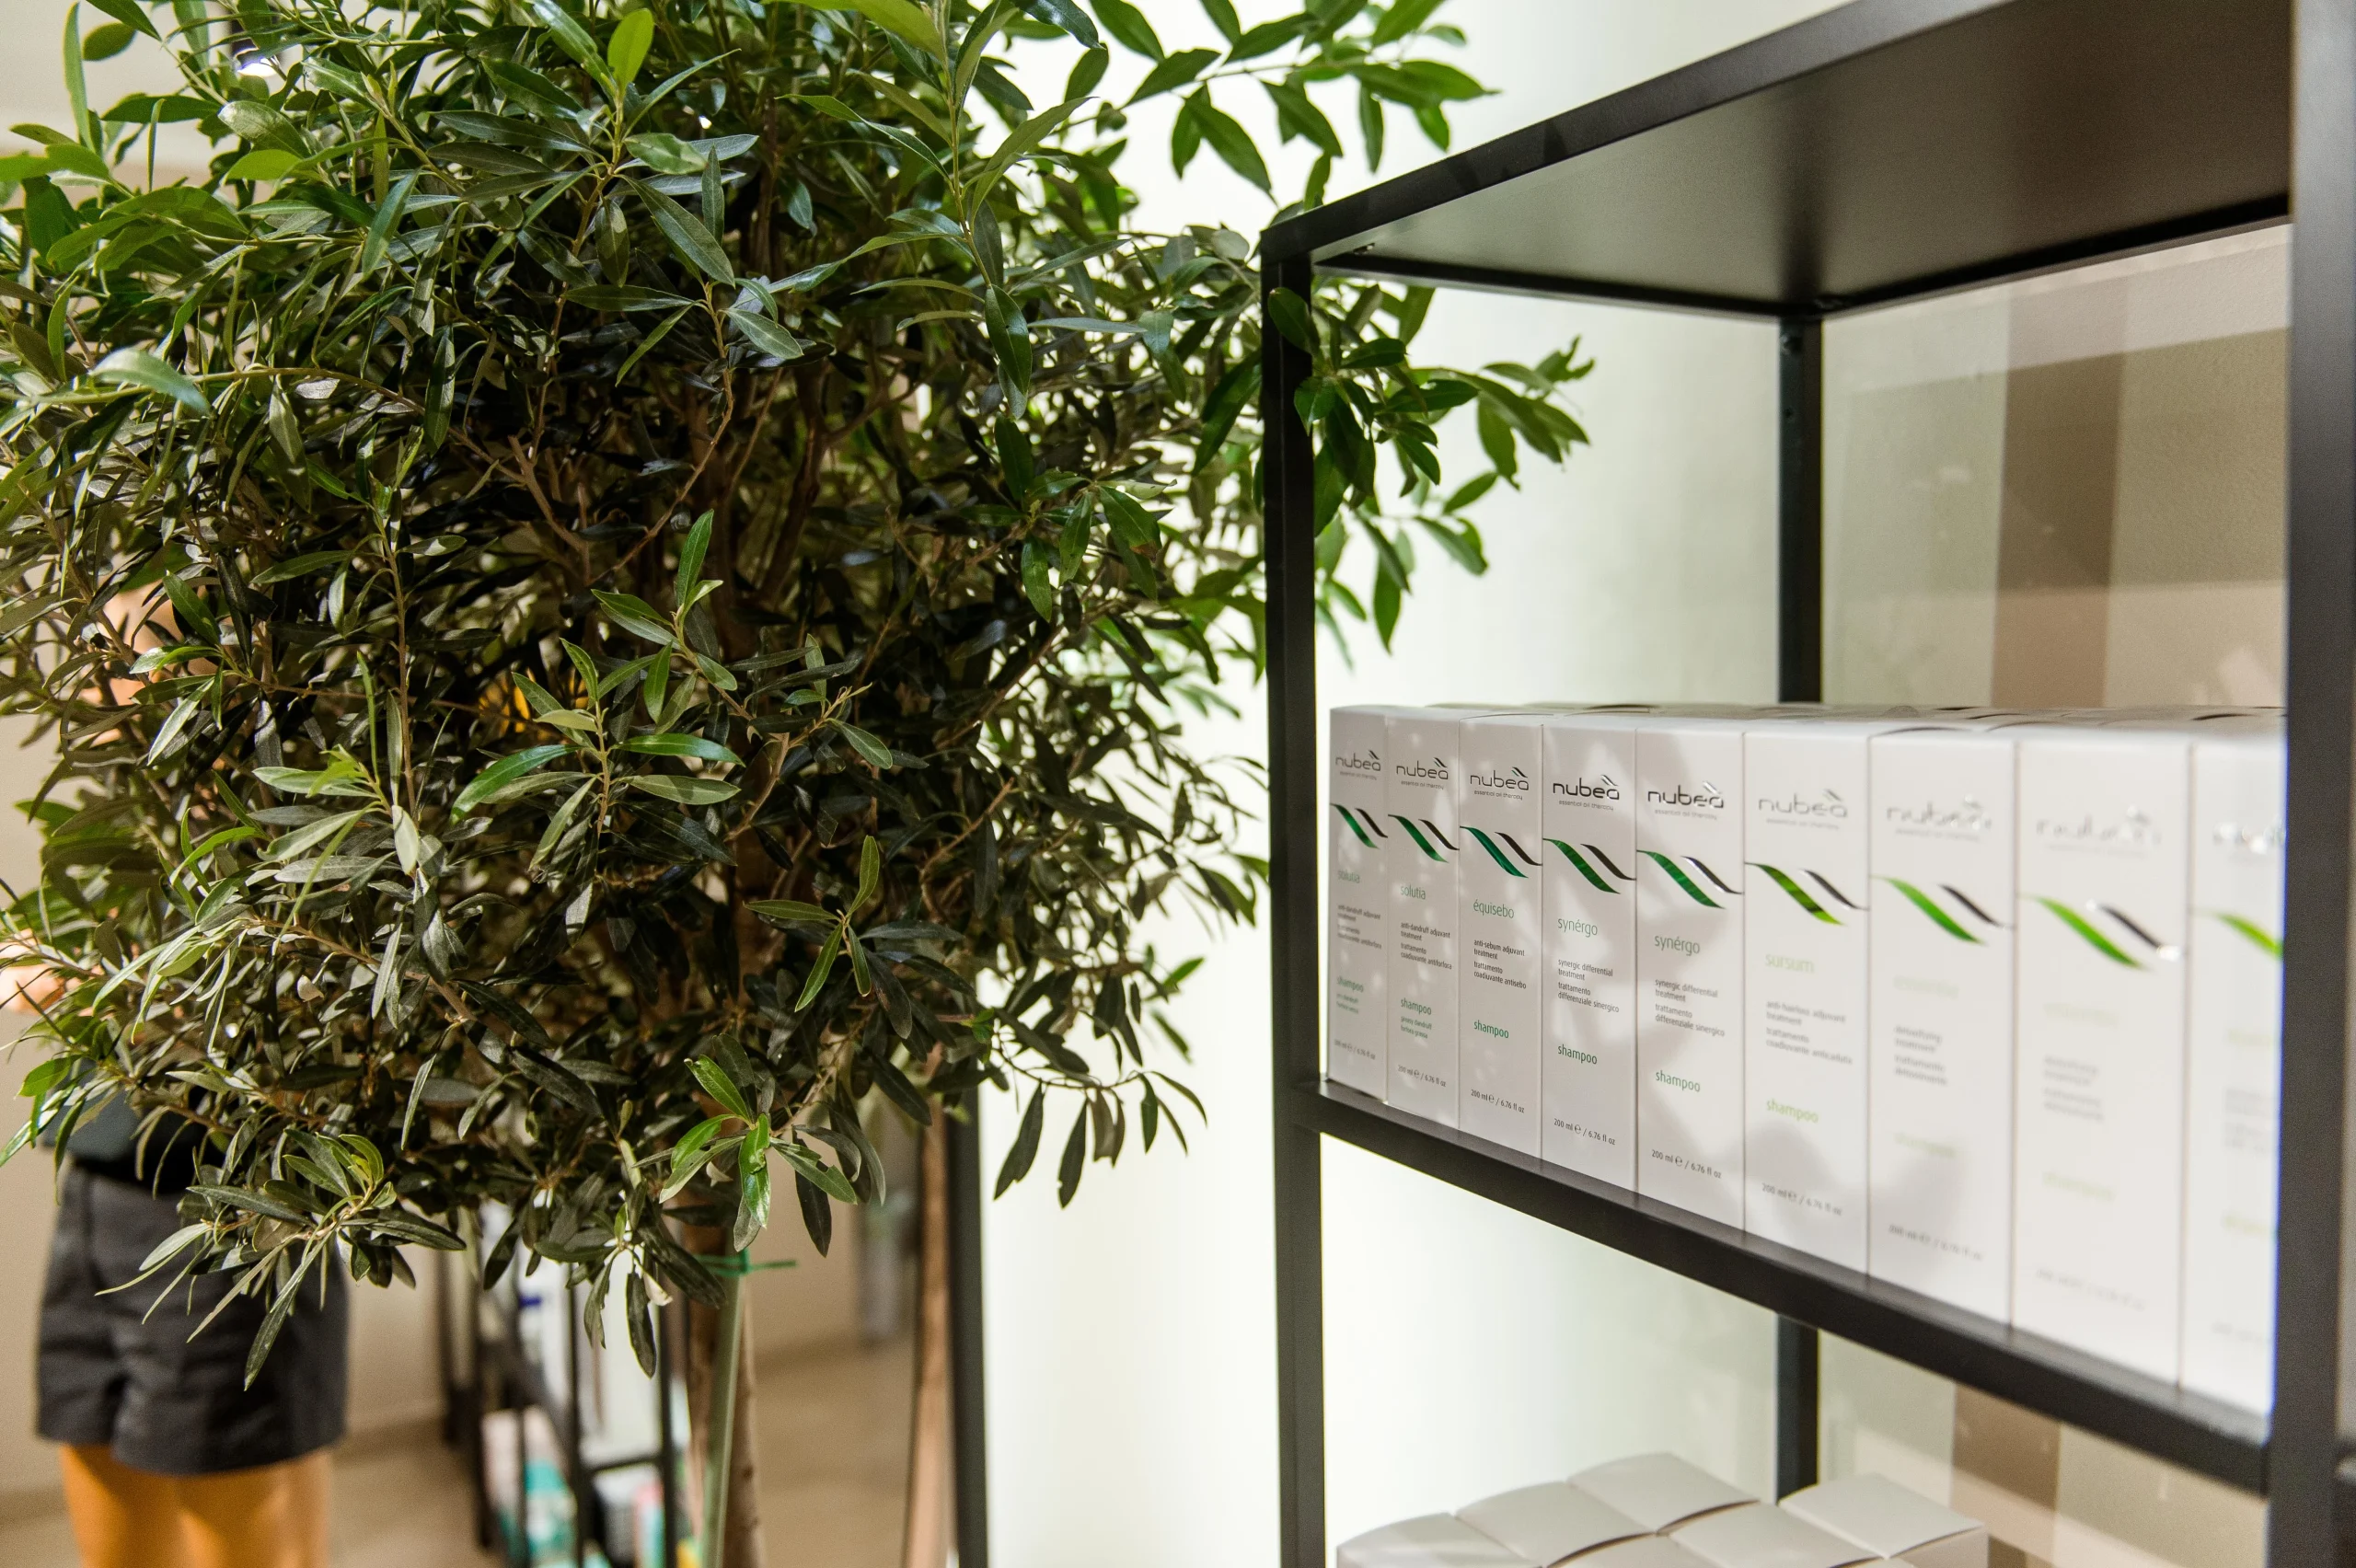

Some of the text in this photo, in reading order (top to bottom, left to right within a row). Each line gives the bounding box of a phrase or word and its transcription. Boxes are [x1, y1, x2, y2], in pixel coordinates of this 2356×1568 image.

[1396, 757, 1449, 779] nubeà
[1470, 767, 1529, 790] nubeà
[1553, 774, 1620, 801] nubeà
[1503, 792, 1523, 801] therapy
[1591, 802, 1614, 812] therapy
[1401, 884, 1426, 900] solutia
[1473, 899, 1514, 918] équisebo
[1557, 917, 1599, 938] synérgo
[1473, 940, 1525, 956] anti-sebum adjuvant
[1473, 948, 1498, 960] treatment
[1654, 935, 1701, 957] synérgo
[1473, 961, 1503, 974] trattamento
[1558, 959, 1613, 976] synergic differential
[1558, 968, 1586, 981] treatment
[1473, 970, 1527, 989] coadiuvante antisebo
[1558, 981, 1591, 996] trattamento
[1655, 979, 1718, 998] synergic differential
[1557, 991, 1620, 1013] differenziale sinergico
[1655, 988, 1686, 1002] treatment
[1401, 997, 1432, 1015] shampoo
[1655, 1003, 1692, 1019] trattamento
[1473, 1020, 1509, 1038] shampoo
[1655, 1013, 1726, 1037] differenziale sinergico
[1557, 1043, 1598, 1065] shampoo
[1655, 1069, 1701, 1092] shampoo
[1471, 1089, 1480, 1099] 200
[1481, 1093, 1488, 1101] ml
[1500, 1099, 1511, 1110] 6.76
[1766, 1097, 1819, 1124] shampoo
[1553, 1118, 1565, 1128] 200
[1565, 1123, 1574, 1131] ml
[1588, 1130, 1601, 1141] 6.76
[1608, 1137, 1616, 1146] oz
[1651, 1148, 1664, 1160] 200
[1665, 1154, 1673, 1163] ml
[1691, 1162, 1705, 1174] 6.76
[1706, 1166, 1712, 1176] fl
[1713, 1170, 1722, 1179] oz
